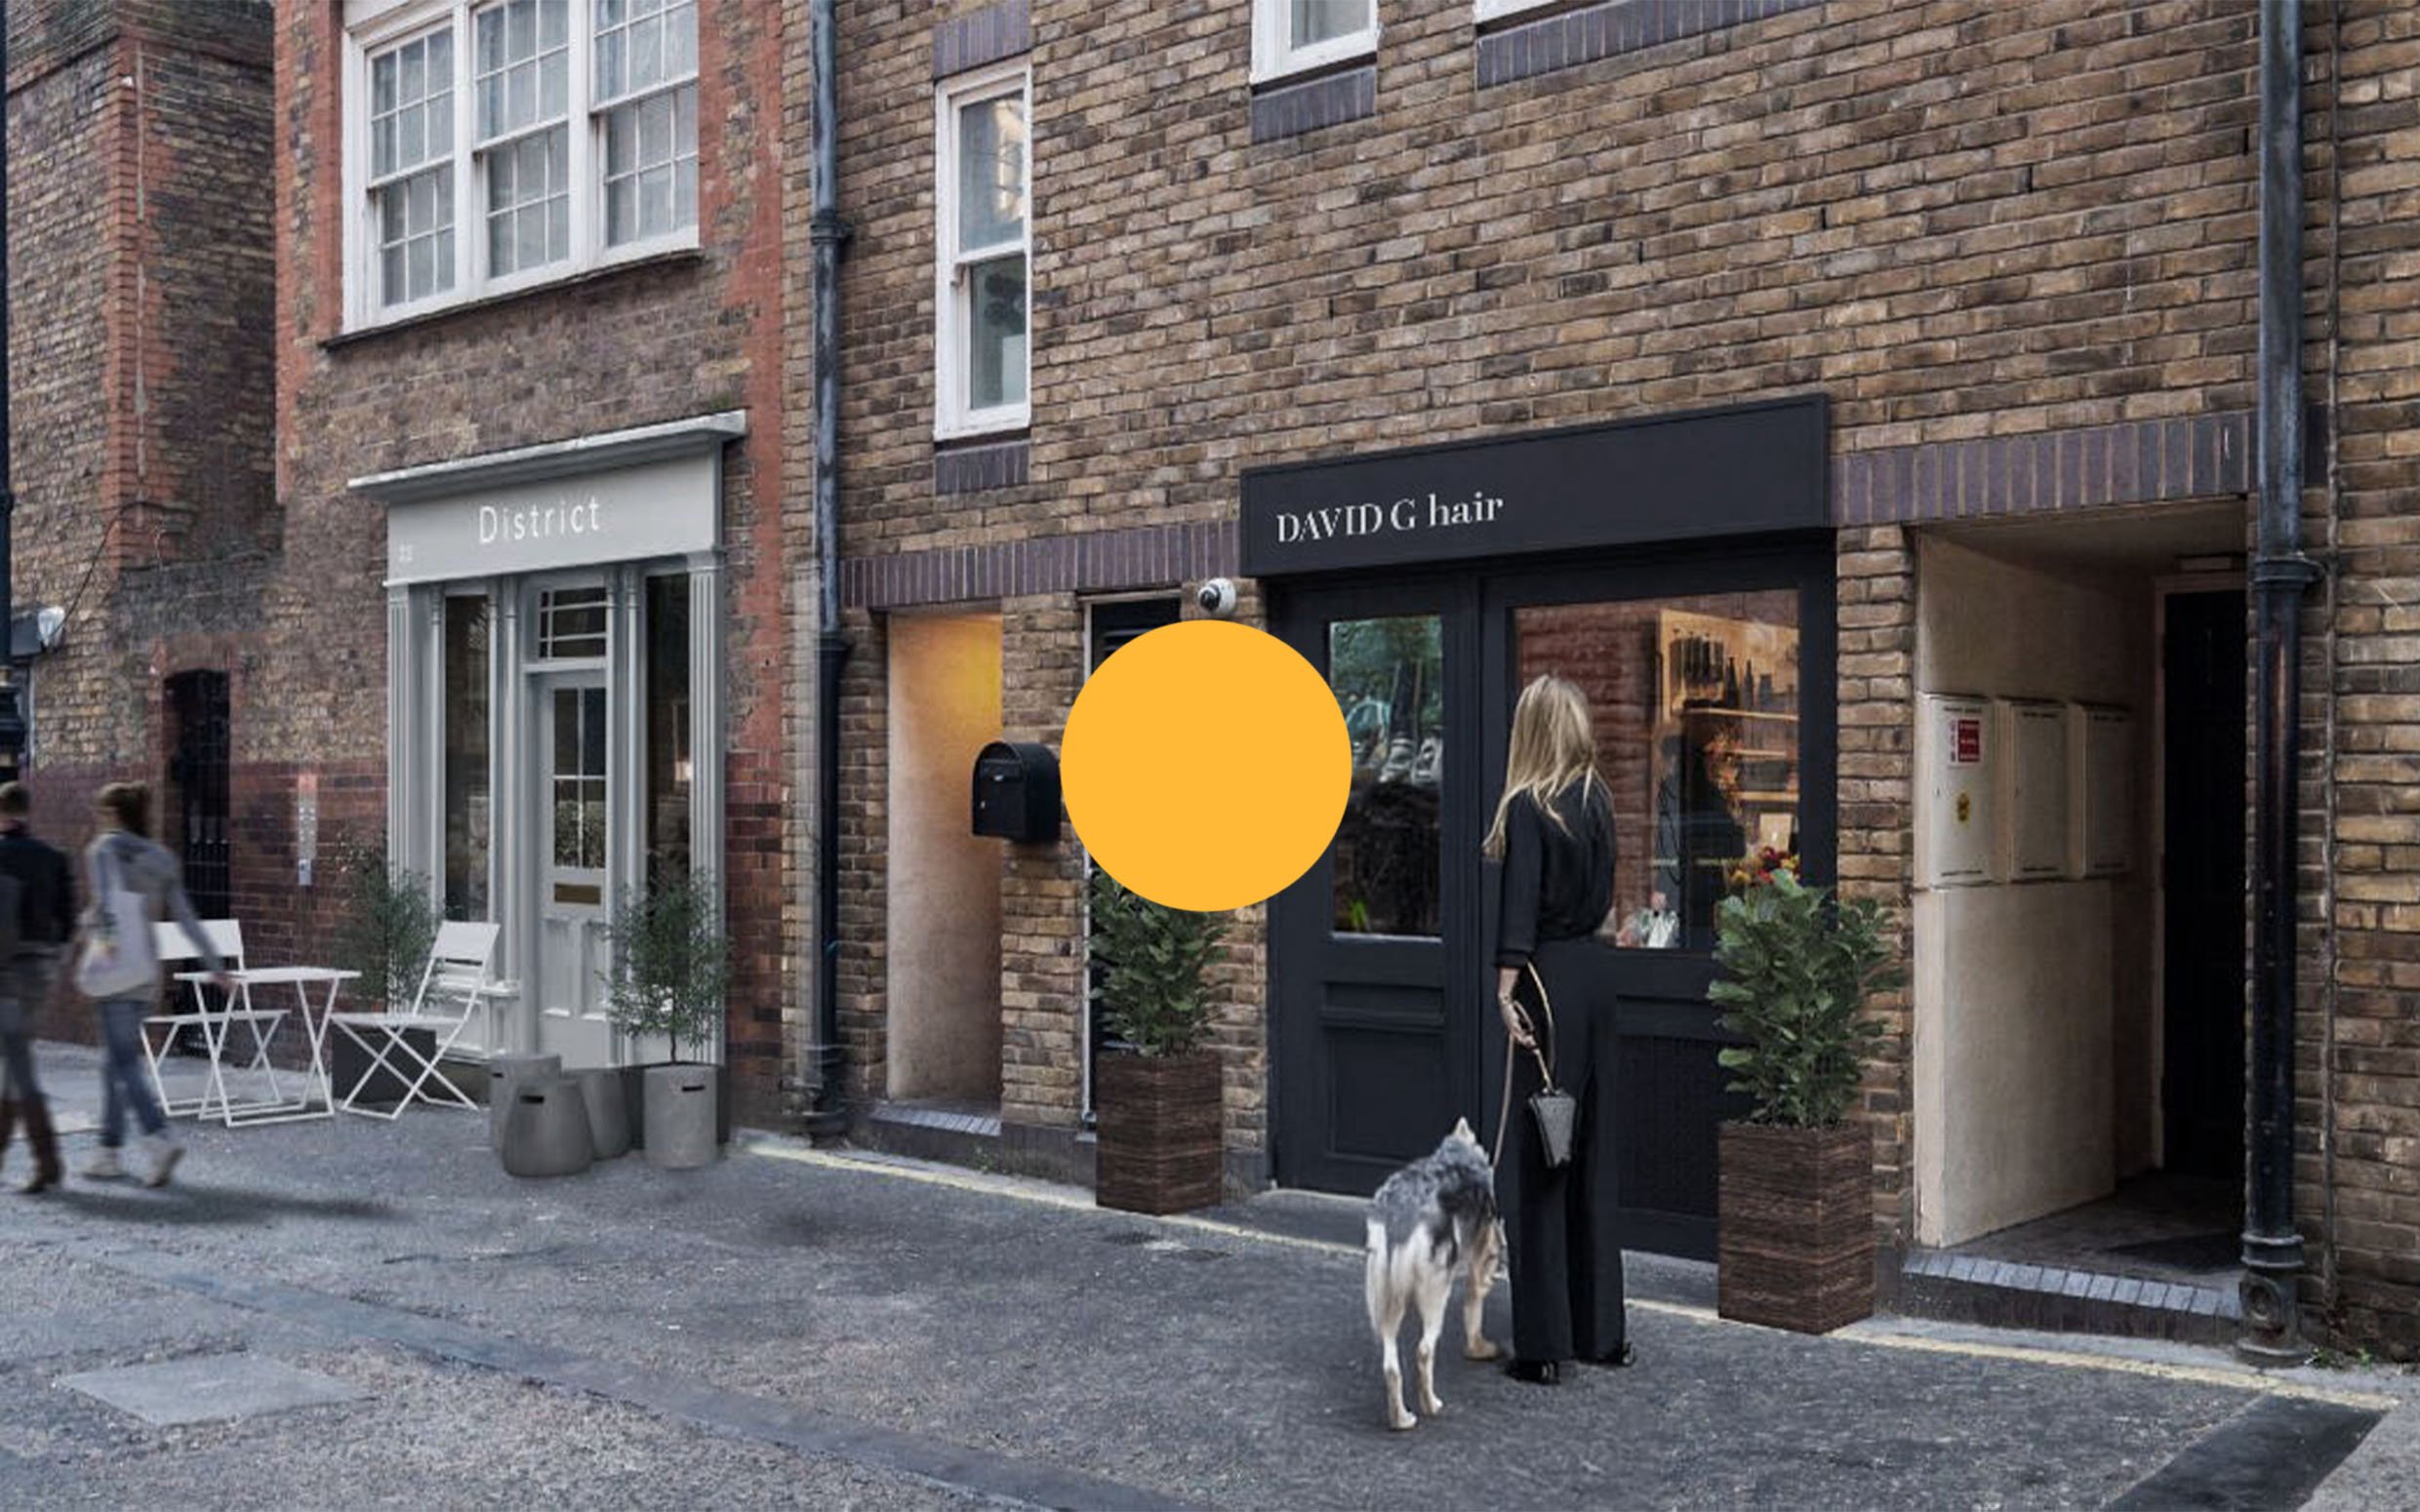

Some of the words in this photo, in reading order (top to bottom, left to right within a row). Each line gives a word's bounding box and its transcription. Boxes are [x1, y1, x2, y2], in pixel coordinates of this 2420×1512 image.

[479, 496, 600, 543] District
[1276, 503, 1384, 542] DAVID
[1391, 498, 1416, 532] G
[1428, 492, 1504, 528] hair
